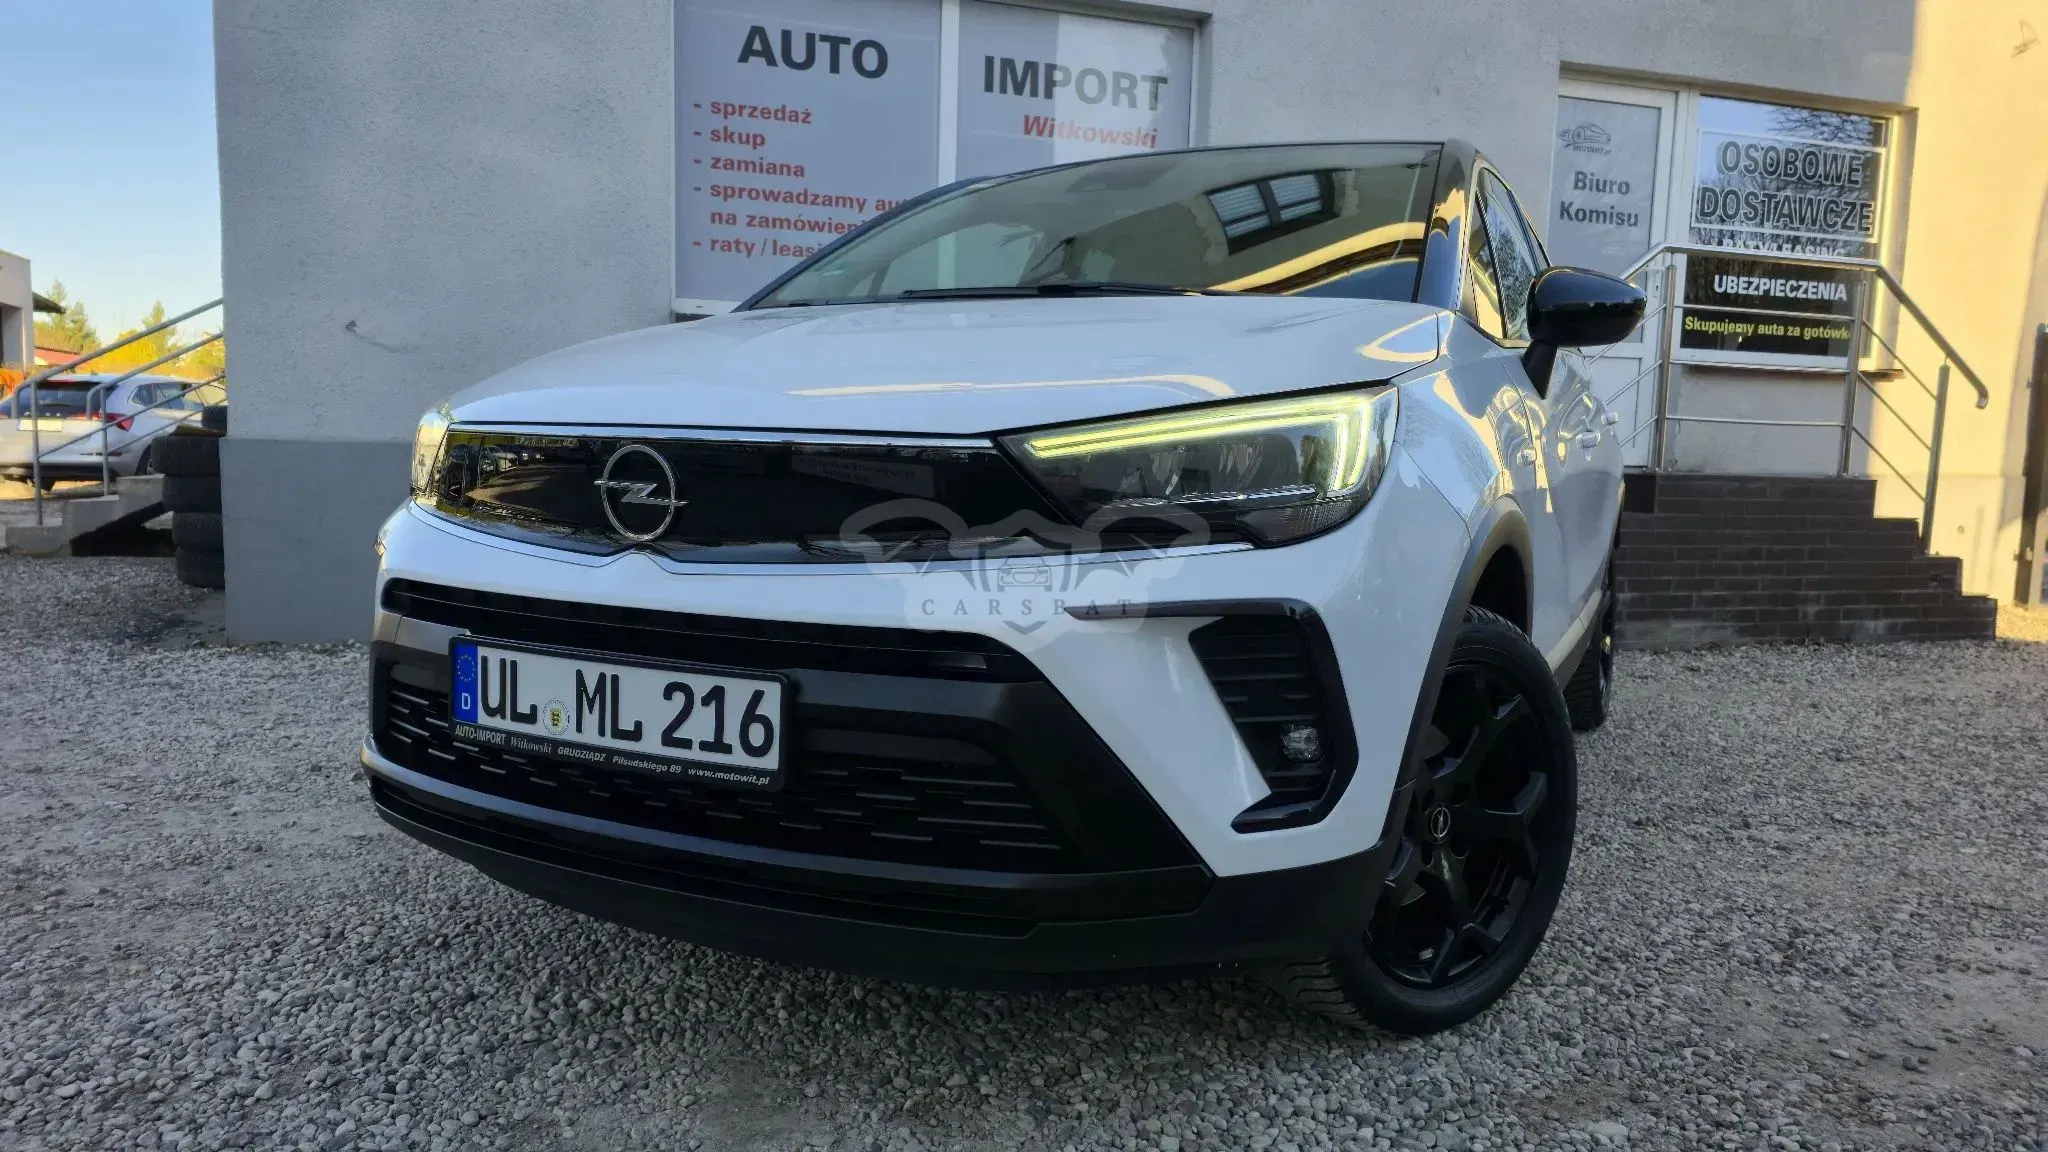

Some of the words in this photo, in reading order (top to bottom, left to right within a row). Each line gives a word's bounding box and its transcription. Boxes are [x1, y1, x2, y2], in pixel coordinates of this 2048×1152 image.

[737, 25, 888, 80] AUTO
[984, 55, 1168, 111] IMPORT
[710, 101, 812, 125] sprzedaż
[710, 125, 766, 150] skup
[1023, 115, 1158, 149] Witkowski
[710, 157, 805, 178] zamiana
[1721, 140, 1863, 188] OSOBOWE
[1573, 170, 1631, 196] Biuro
[710, 184, 867, 213] sprowadzamy
[1698, 185, 1873, 235] DOSTAWCZE
[710, 211, 737, 226] na
[745, 213, 866, 235] zamówien
[1559, 200, 1639, 227] Komisu
[710, 238, 756, 258] raty
[1714, 274, 1848, 301] UBEZPIECZENIA
[1684, 316, 1756, 337] Skupujemy
[1757, 324, 1785, 337] auta
[1786, 326, 1801, 337] za
[1803, 324, 1851, 340] gotówk
[461, 692, 471, 710] D
[481, 655, 538, 725] UL
[576, 669, 643, 742] ML
[661, 681, 775, 758] 216
[454, 724, 506, 746] AUTO-IMPORT
[510, 736, 552, 754] Witkowski
[557, 746, 607, 762] GRUDZIĄDZ
[669, 764, 682, 774] 89
[688, 767, 770, 786] www.motowit.pl
